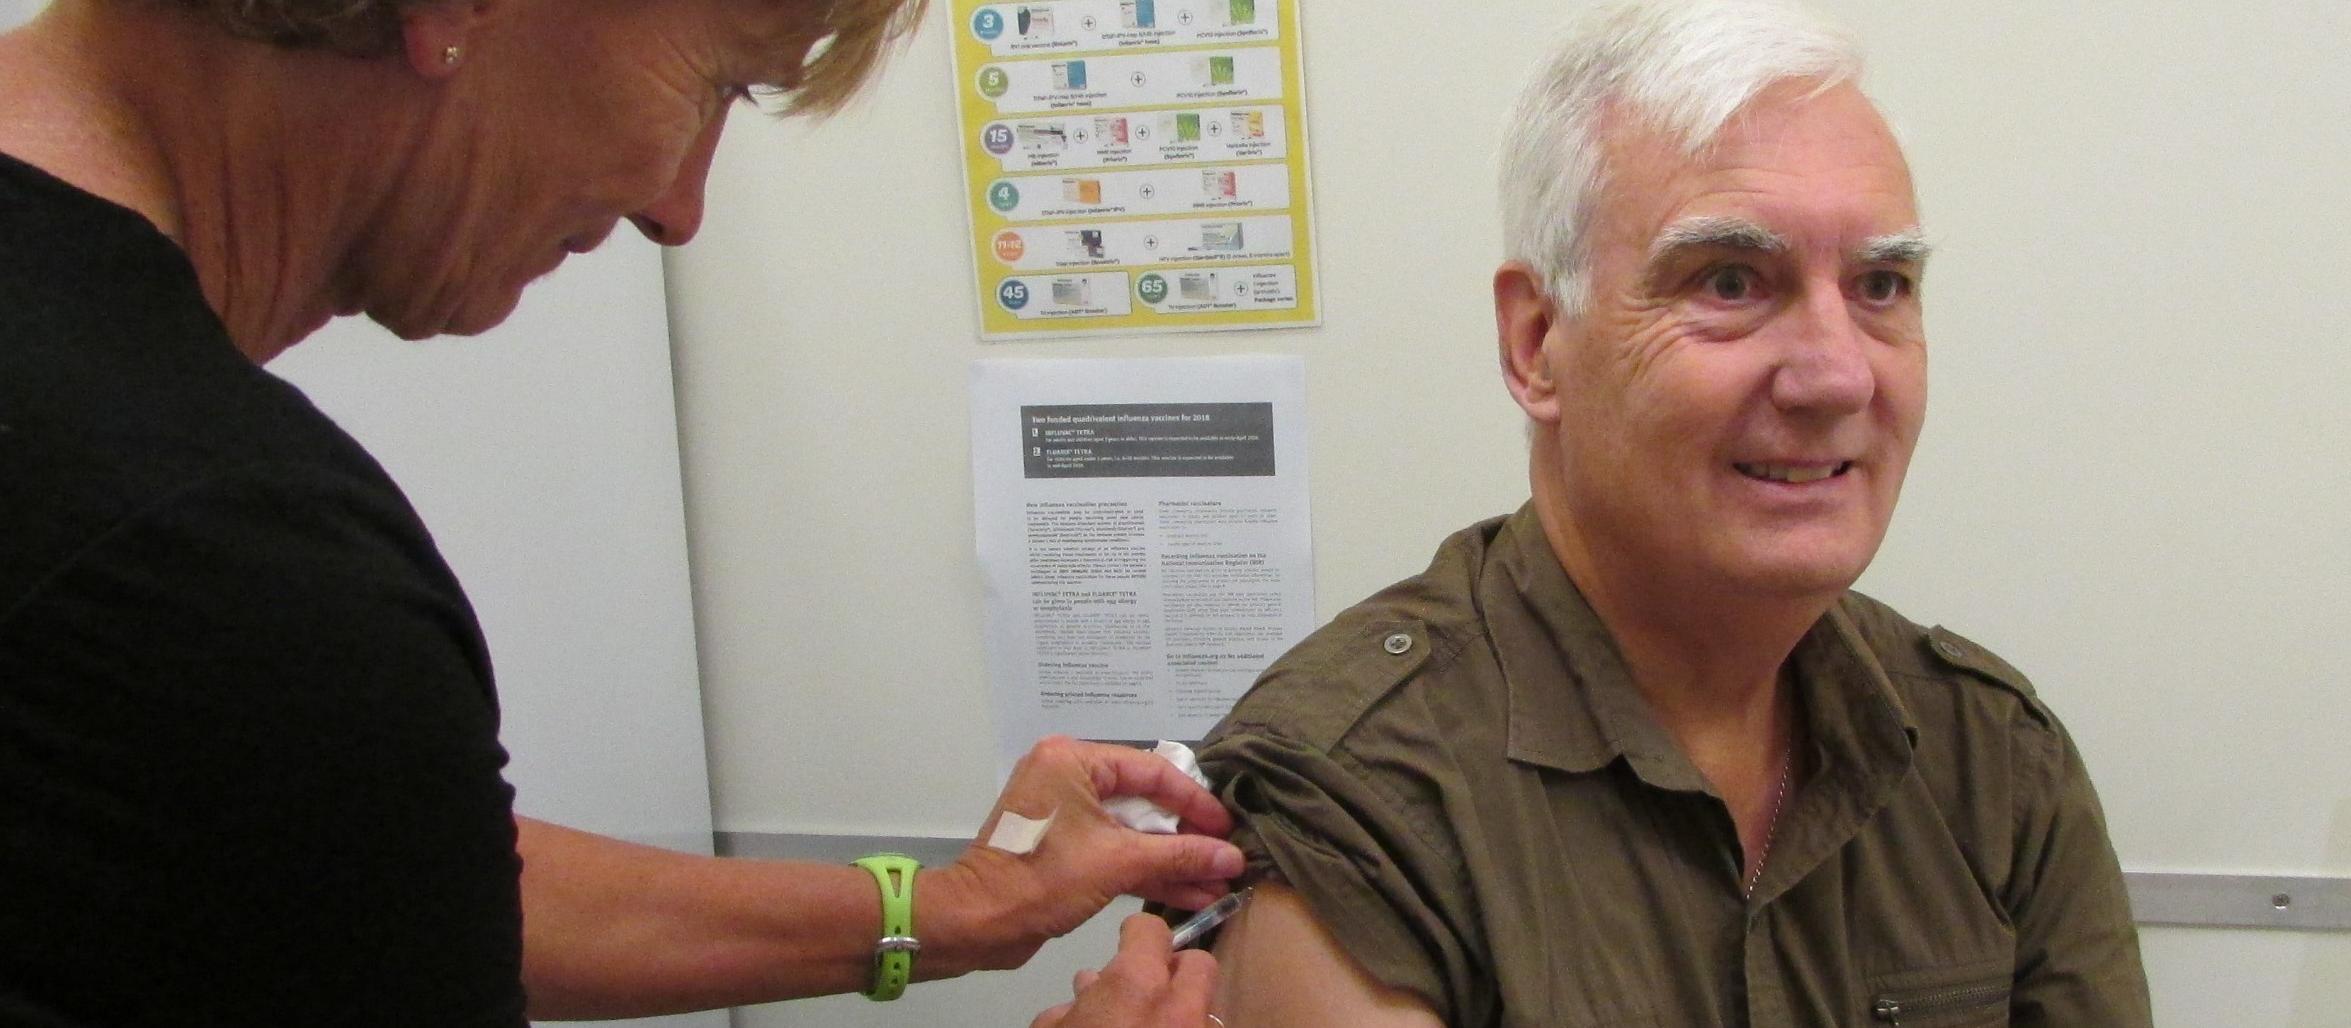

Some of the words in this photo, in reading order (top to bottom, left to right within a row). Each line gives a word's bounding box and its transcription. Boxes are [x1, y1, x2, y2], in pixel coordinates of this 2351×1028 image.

[982, 13, 994, 28] 3
[988, 71, 999, 86] 5
[989, 129, 1007, 143] 15
[998, 186, 1010, 201] 4
[1002, 286, 1024, 299] 45
[1141, 279, 1163, 293] 65
[1047, 415, 1072, 423] funded
[1072, 415, 1116, 424] quadrivalent
[1150, 414, 1180, 423] vaccines
[1192, 413, 1210, 421] 2018
